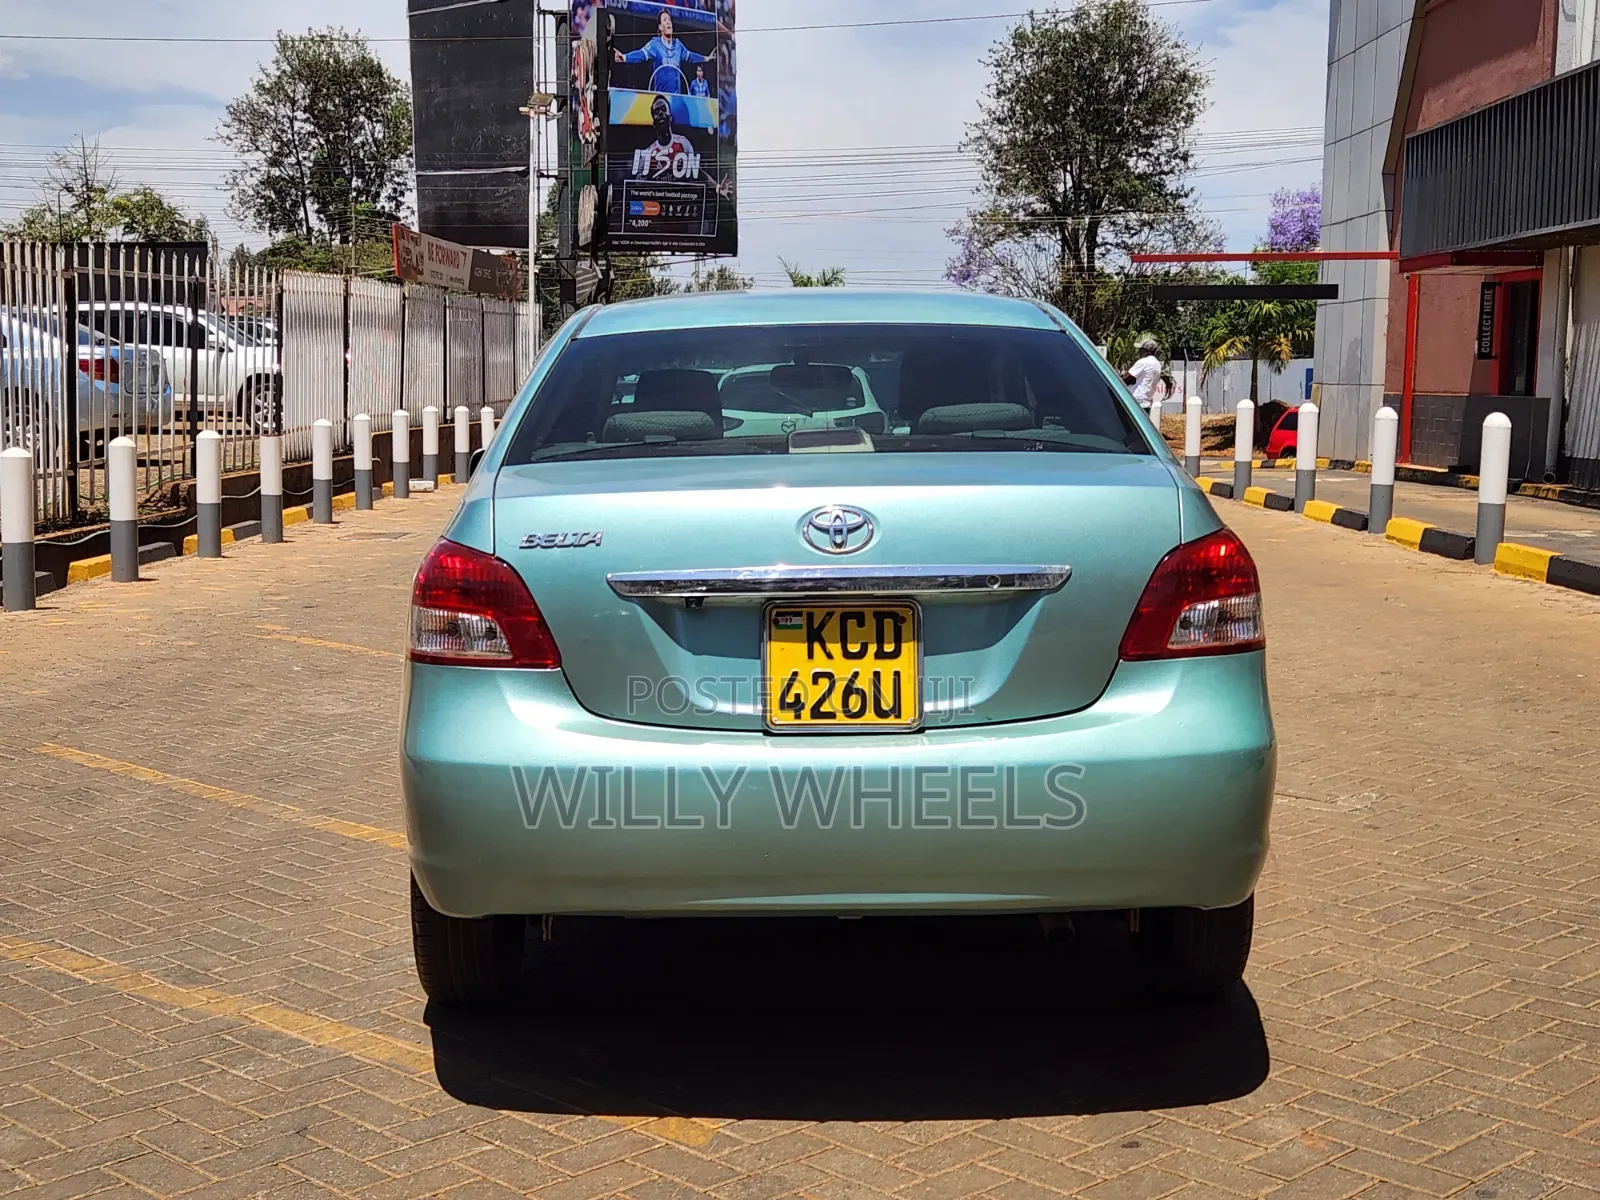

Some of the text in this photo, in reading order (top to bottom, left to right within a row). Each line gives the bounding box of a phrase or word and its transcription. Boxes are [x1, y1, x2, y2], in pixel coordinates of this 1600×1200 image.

[631, 147, 701, 179] IT'S ON
[428, 241, 459, 269] BE FORWARD
[1481, 289, 1493, 353] COLLECT HERE
[519, 530, 604, 549] BELTA
[806, 610, 903, 660] KCD
[778, 670, 902, 720] 426U
